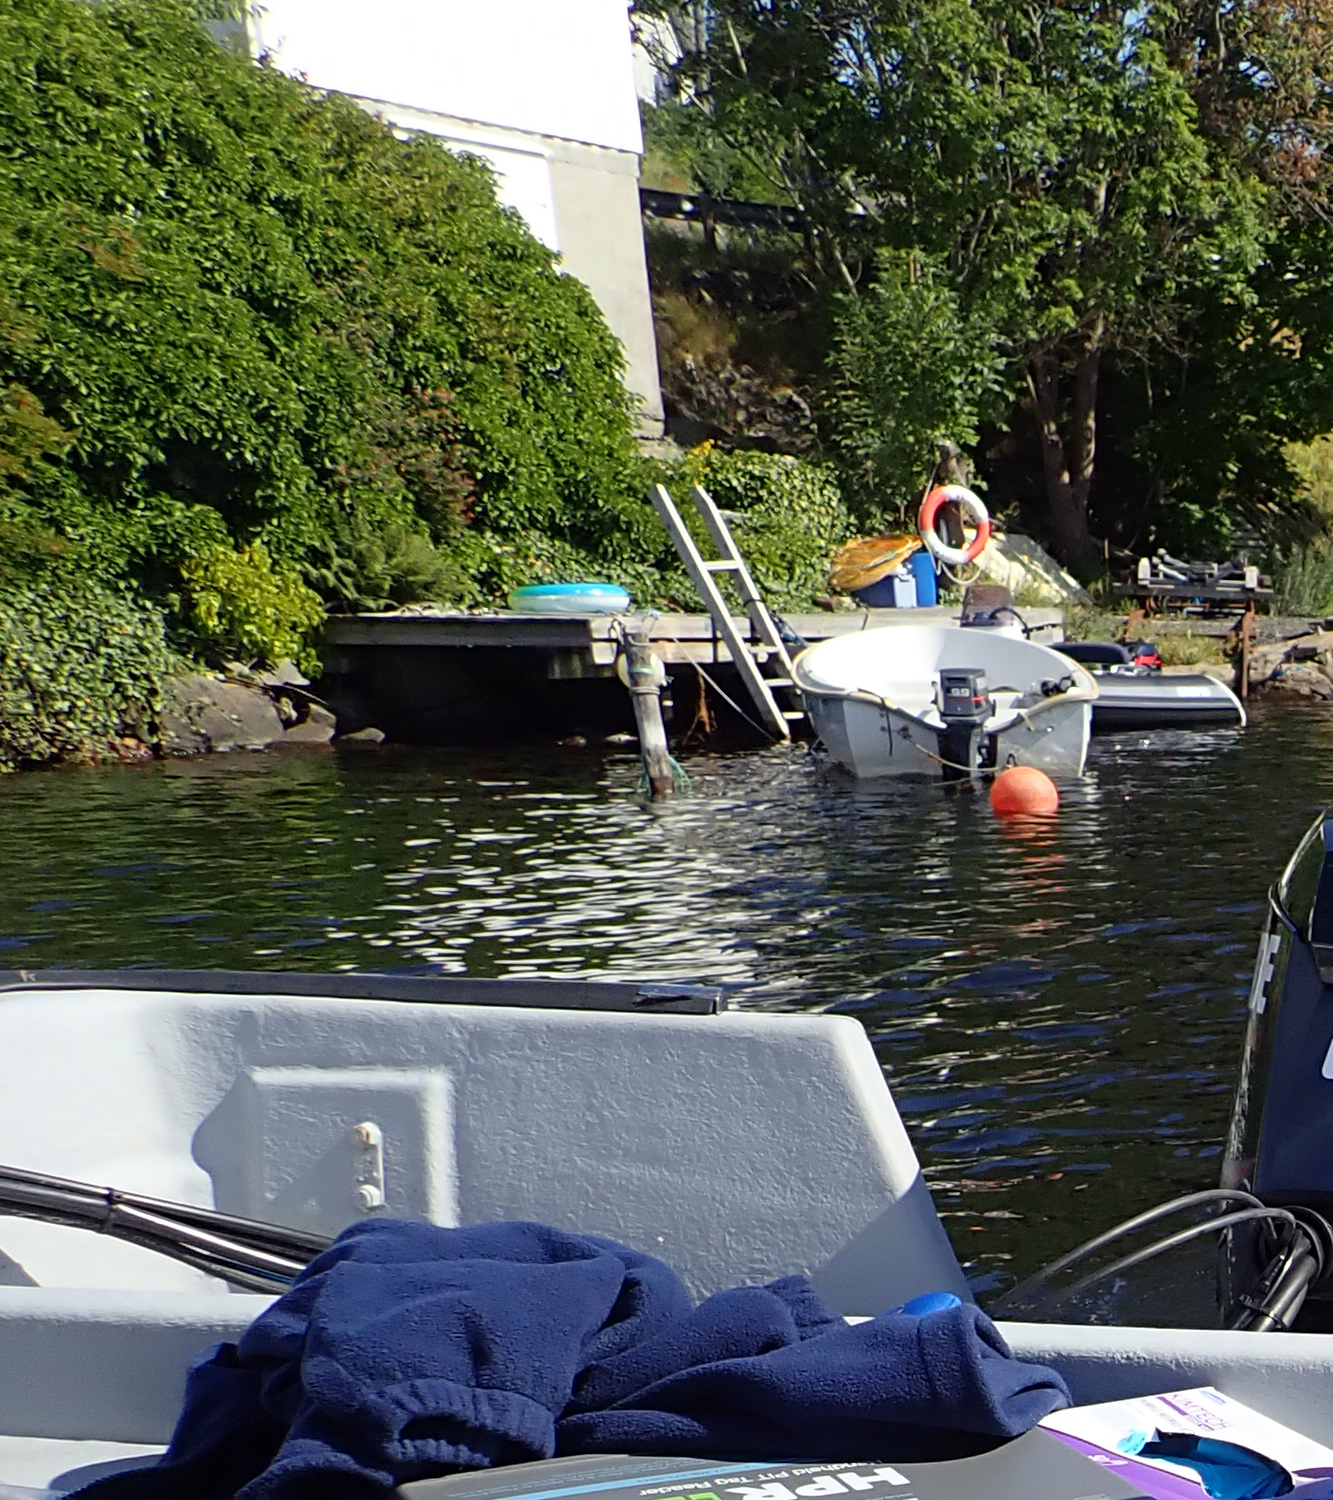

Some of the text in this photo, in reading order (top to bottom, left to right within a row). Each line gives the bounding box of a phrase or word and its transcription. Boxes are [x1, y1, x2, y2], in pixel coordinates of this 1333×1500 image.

[638, 1461, 881, 1497] andheld PIT Tag Reader
